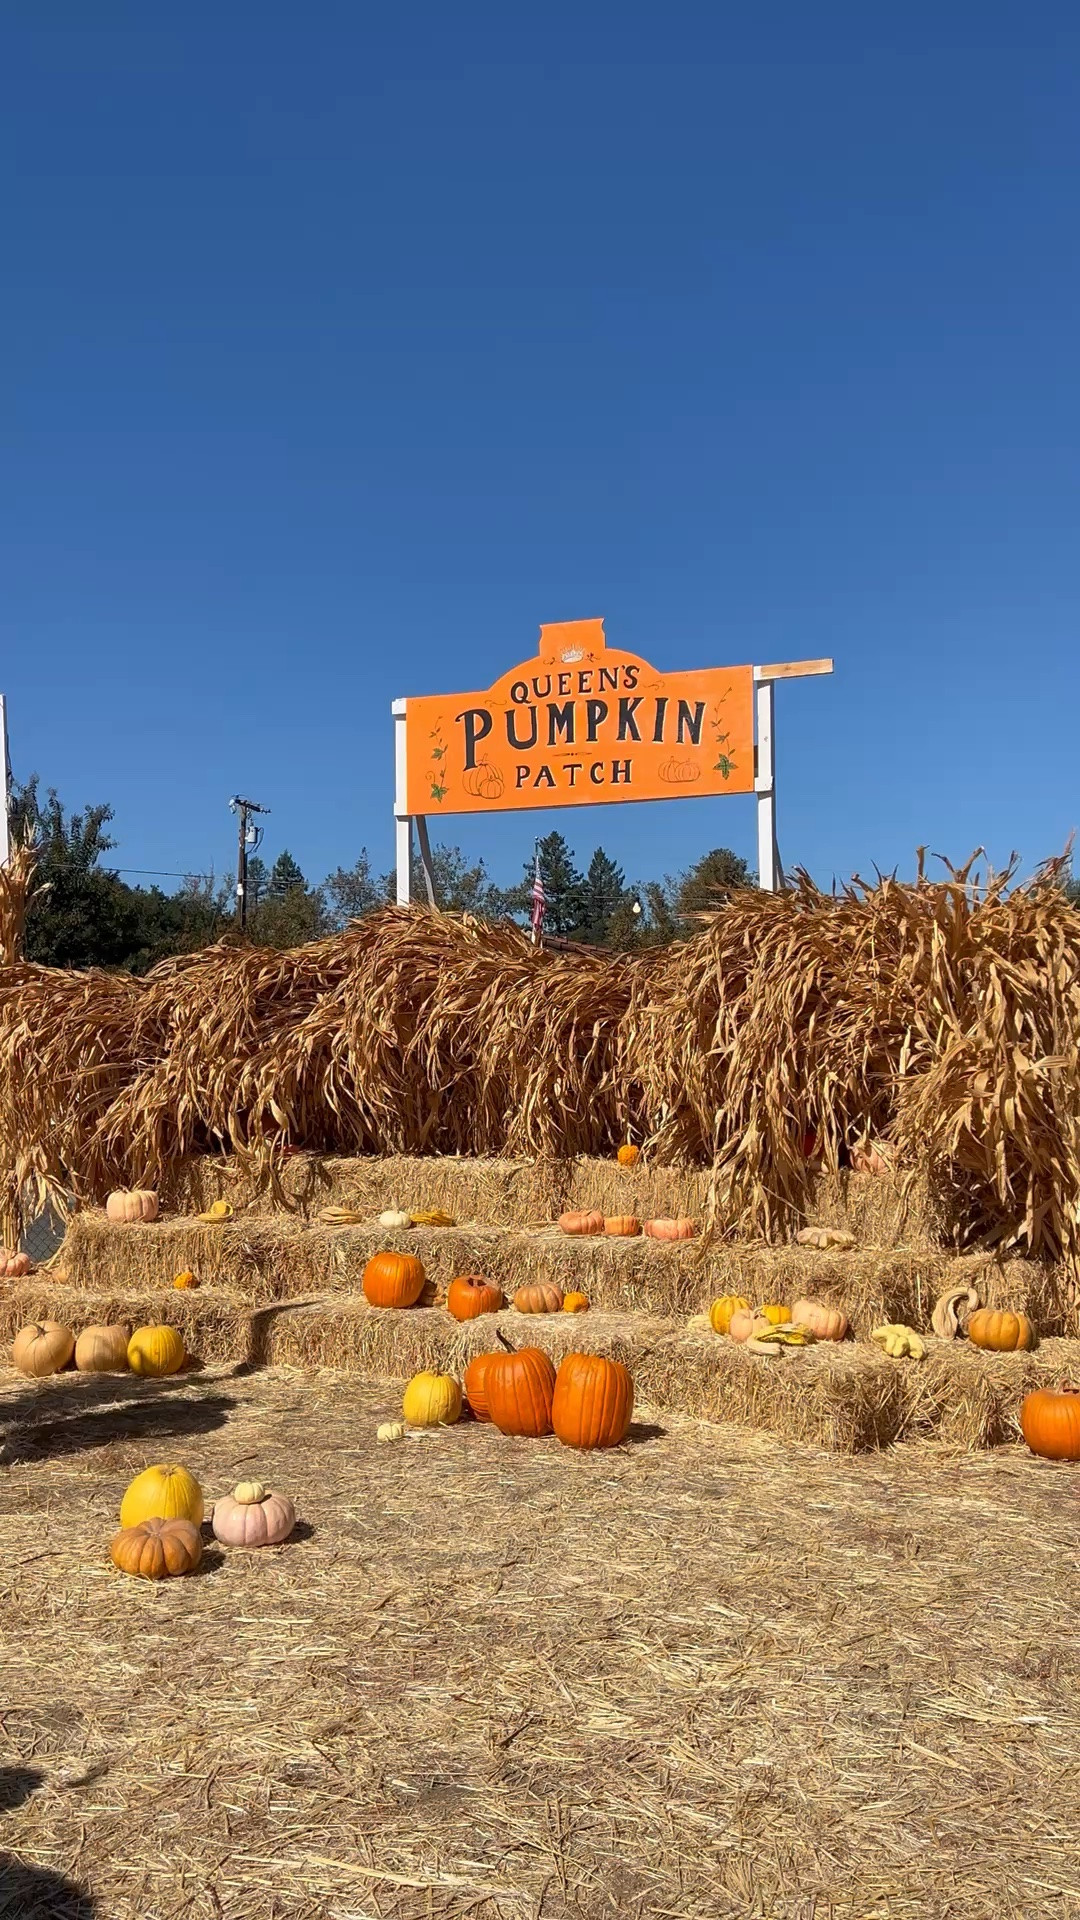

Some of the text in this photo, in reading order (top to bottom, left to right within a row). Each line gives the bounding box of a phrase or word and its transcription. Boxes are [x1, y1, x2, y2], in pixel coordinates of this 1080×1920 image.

[510, 664, 640, 704] QUEEN'S
[455, 697, 706, 771] PUMPKIN
[515, 759, 632, 788] PATCH
